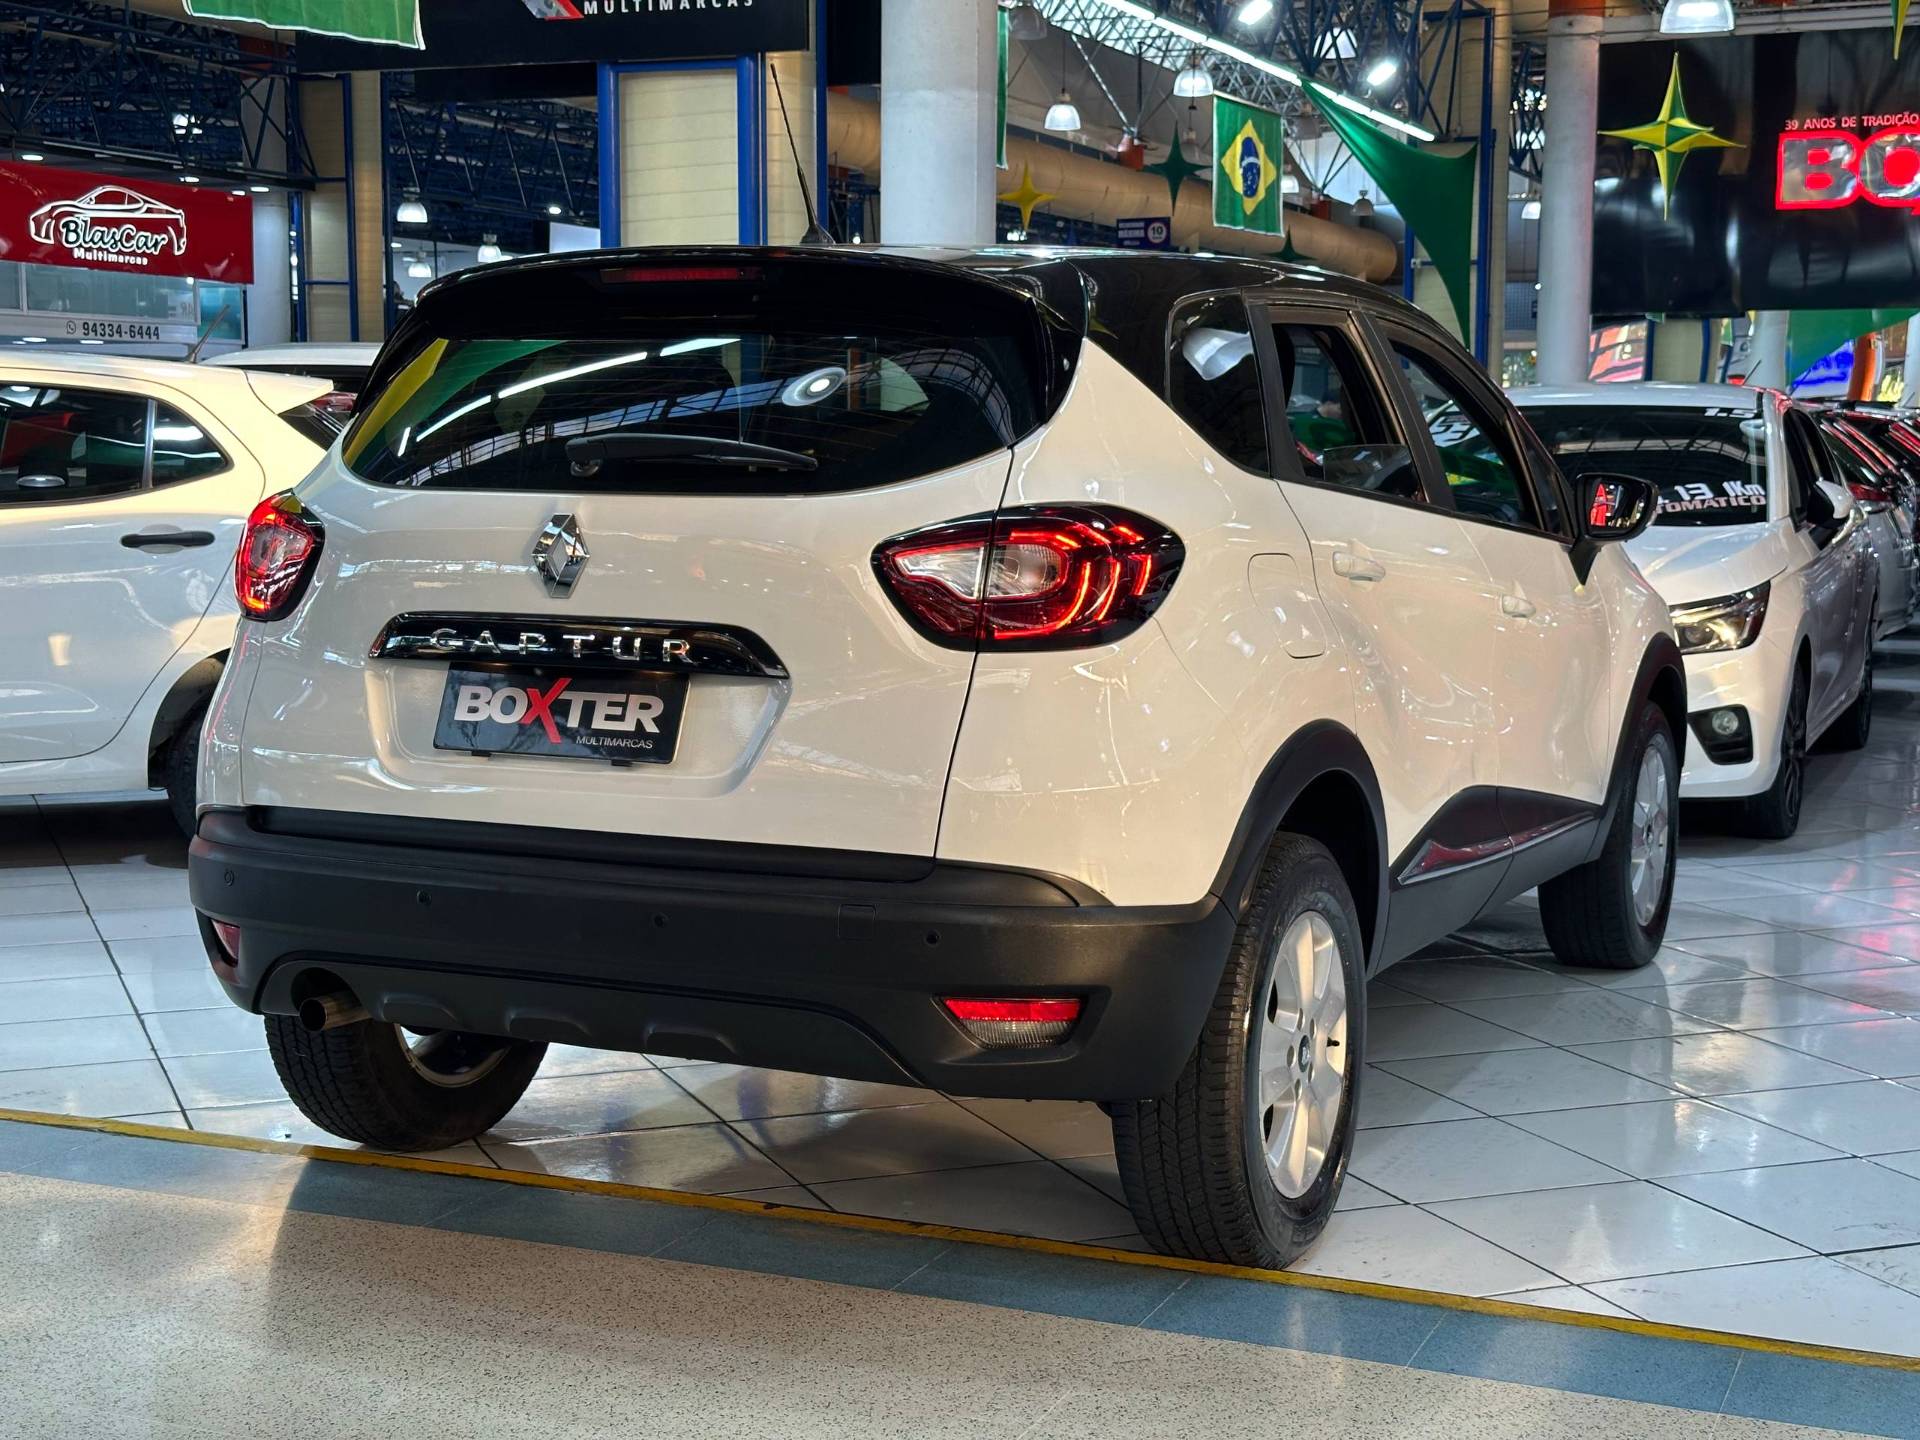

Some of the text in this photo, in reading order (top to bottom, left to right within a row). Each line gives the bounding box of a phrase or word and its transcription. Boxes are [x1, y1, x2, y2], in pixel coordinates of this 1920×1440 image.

[1785, 112, 1919, 130] 39 ANOS DE TRADIÇÃO
[1778, 130, 1920, 208] BO
[60, 216, 169, 255] BlasCar
[1152, 225, 1164, 236] 10
[73, 248, 148, 265] Multimarcas
[82, 321, 160, 340] 94334-6444
[1674, 482, 1715, 501] 13
[1656, 495, 1767, 514] TOMATICO
[430, 628, 698, 665] CAPTUR
[454, 678, 664, 744] BOXTER
[576, 735, 653, 749] MULTIMARCAS
